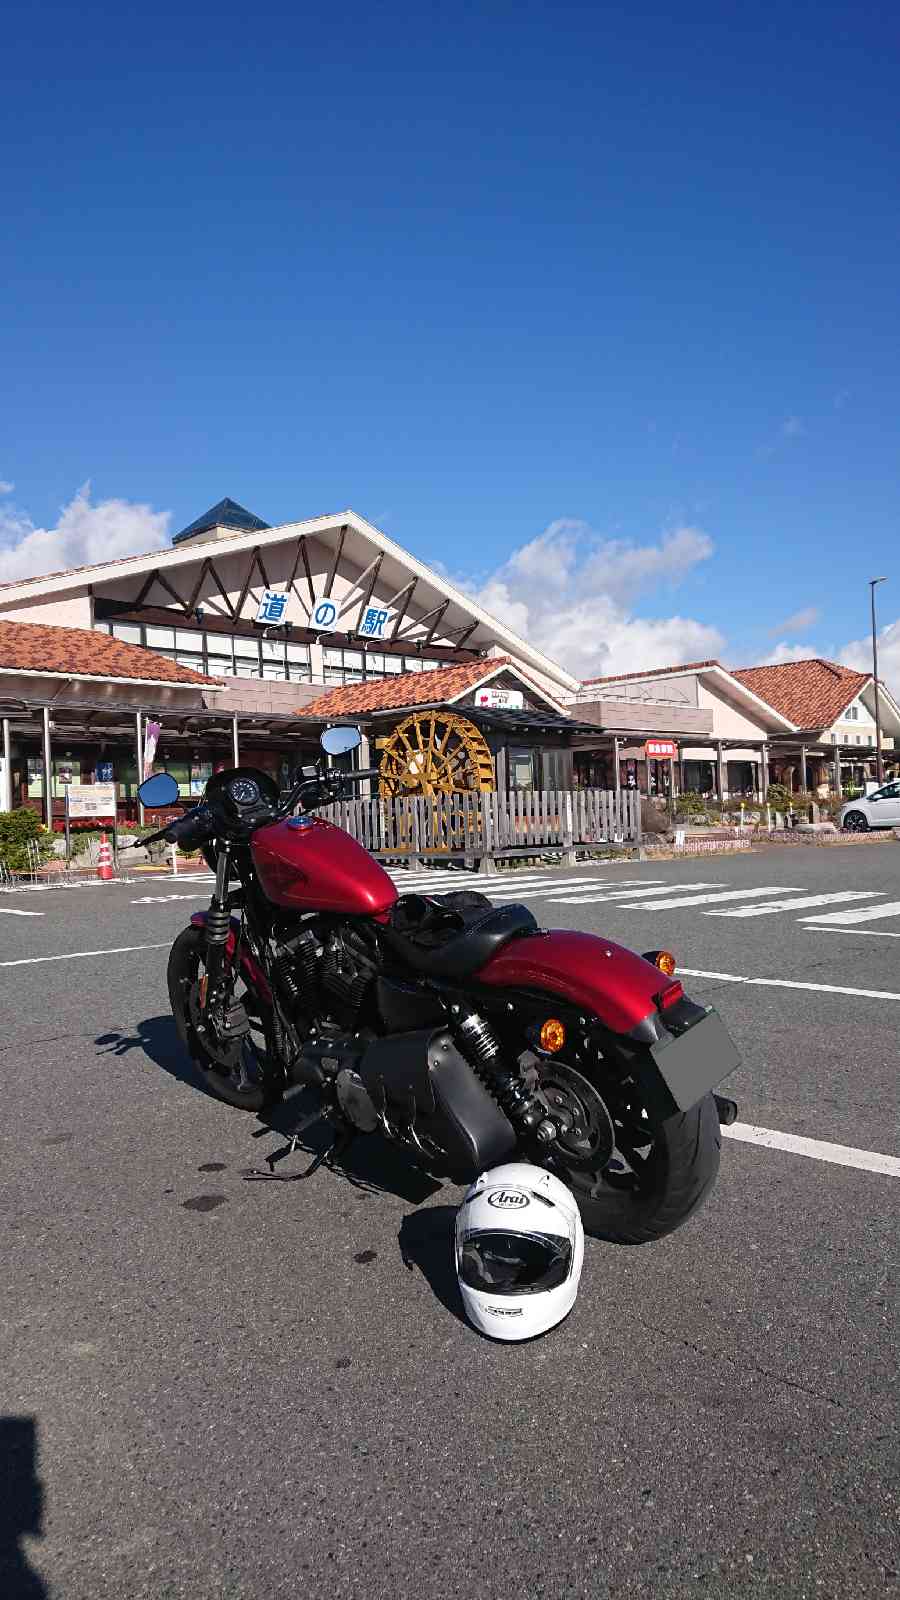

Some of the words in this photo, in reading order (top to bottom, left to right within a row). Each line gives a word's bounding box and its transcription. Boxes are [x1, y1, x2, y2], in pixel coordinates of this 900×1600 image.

[259, 593, 388, 635] 道の駅
[493, 1191, 524, 1204] Arai
